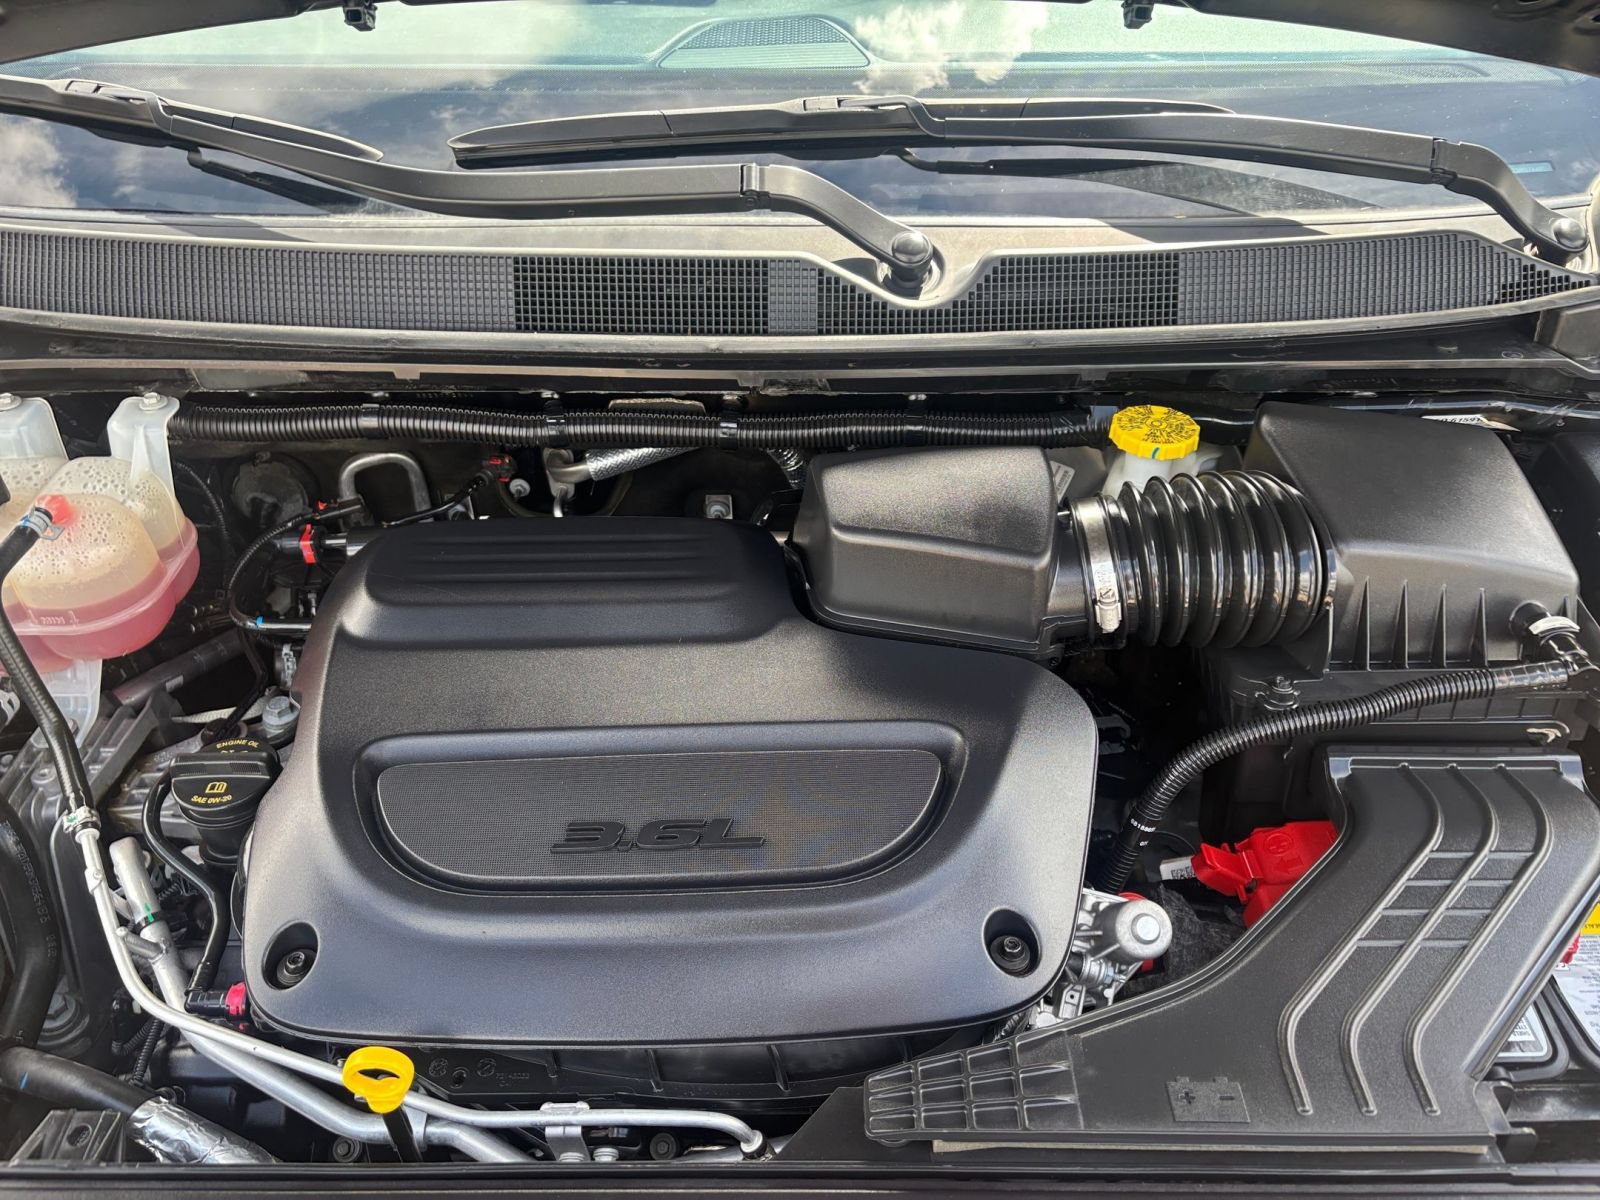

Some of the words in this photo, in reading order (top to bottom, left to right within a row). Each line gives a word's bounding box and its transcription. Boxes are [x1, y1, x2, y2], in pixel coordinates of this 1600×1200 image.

[216, 739, 248, 749] ENGINE
[248, 740, 260, 748] OIL
[191, 794, 207, 804] SAE
[207, 794, 233, 804] 0W-20
[550, 818, 767, 854] 3.6L
